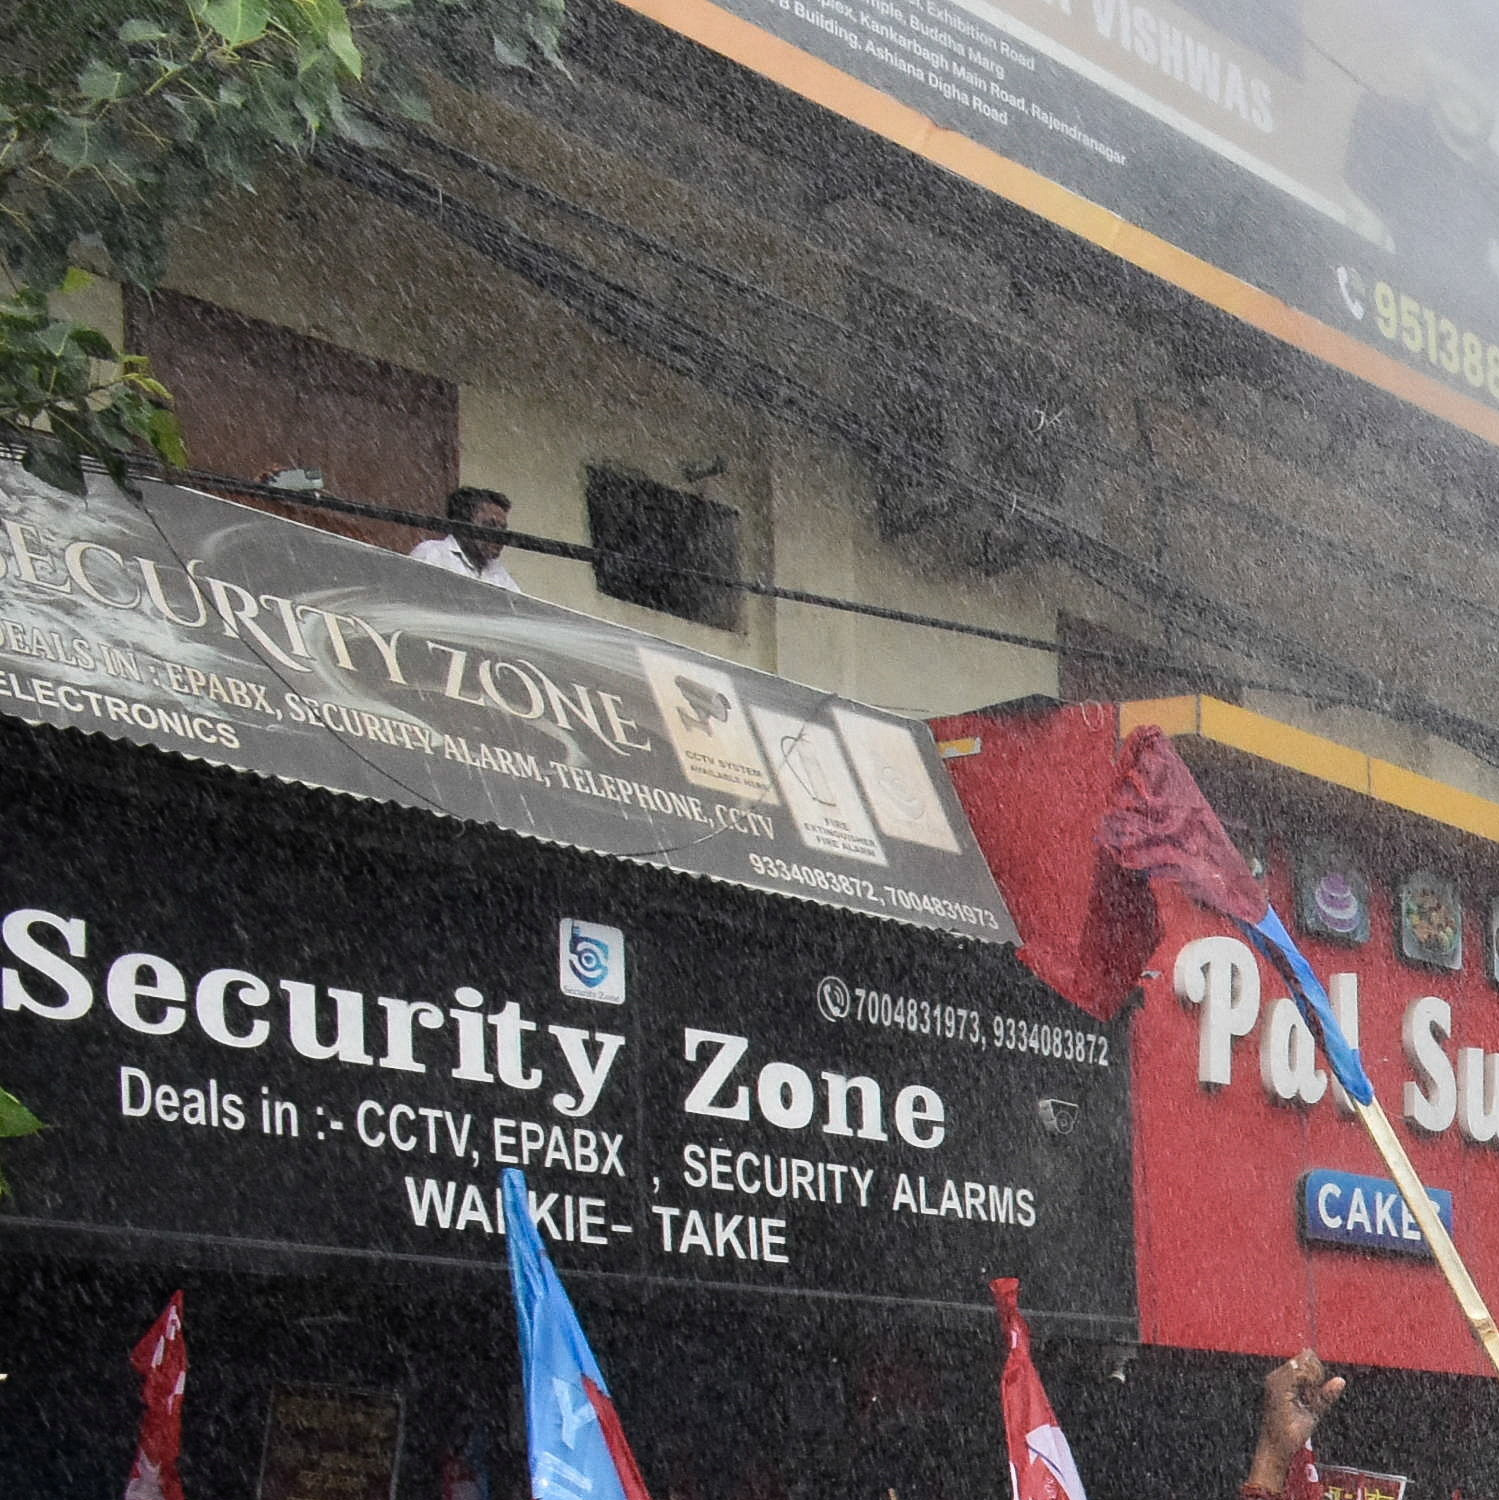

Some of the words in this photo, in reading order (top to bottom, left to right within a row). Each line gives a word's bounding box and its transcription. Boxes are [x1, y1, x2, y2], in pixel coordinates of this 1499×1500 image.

[794, 1, 862, 50] Building,
[865, 40, 924, 81] Ashiana
[928, 71, 969, 107] Digha
[971, 96, 1008, 126] Road
[910, 14, 965, 57] Buddha
[968, 48, 1005, 80] Marg
[927, 1, 997, 49] Exhibition
[1001, 41, 1035, 70] Road
[860, 10, 949, 71] Kankarbagh
[952, 62, 986, 91] Main
[1032, 104, 1127, 166] Rajendranagar
[0, 519, 408, 685] ECURITY
[427, 641, 651, 756] ZONE
[99, 643, 140, 682] IN
[171, 663, 283, 722] EPABX,
[285, 693, 434, 755] SECURITY
[444, 734, 551, 788] ALARM,
[550, 761, 714, 828] TELEPHONE,
[715, 804, 775, 841] CCTV
[750, 853, 886, 907] 9334083872,
[884, 886, 999, 930] 7004831973
[1, 908, 625, 1116] Security
[684, 1027, 946, 1149] Zone
[854, 988, 986, 1052] 7004831973,
[992, 1015, 1109, 1066] 9334083872
[120, 1066, 246, 1131] Deals
[261, 1086, 299, 1138] in
[356, 1099, 480, 1167] CCTV,
[493, 1118, 625, 1178] EPABX
[684, 1143, 874, 1207] SECURITY
[893, 1172, 1036, 1227] ALARMS
[651, 1205, 790, 1263] TAKIE
[1317, 1182, 1442, 1244] CAKE
